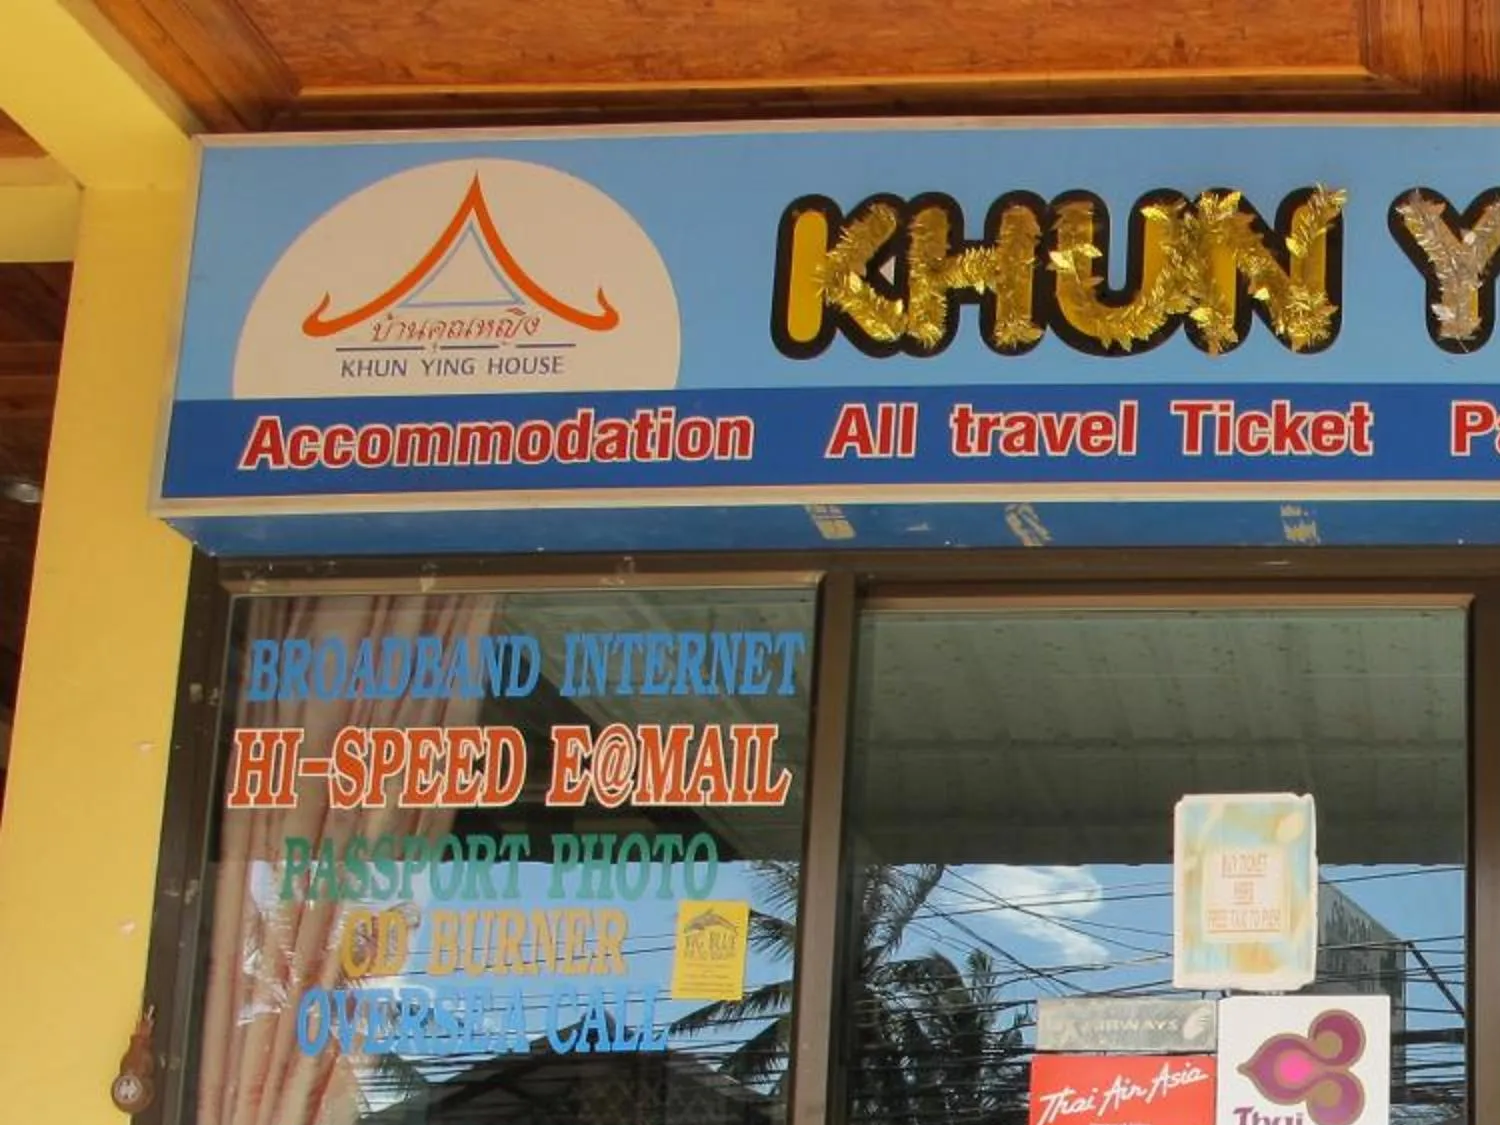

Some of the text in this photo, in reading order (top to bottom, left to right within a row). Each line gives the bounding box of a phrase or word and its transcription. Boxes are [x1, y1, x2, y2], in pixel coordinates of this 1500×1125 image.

[771, 188, 1346, 359] KHUN
[340, 355, 566, 378] KHUN YING HOUSE
[238, 406, 755, 471] Accommodation
[825, 403, 919, 460] All
[950, 401, 1139, 460] travel
[1170, 399, 1375, 458] Ticket
[246, 631, 806, 702] BROADBAND INTERNET
[227, 724, 792, 809] HI-SPEED E@MAIL
[279, 832, 719, 900] PASSPORT PHOTO
[341, 909, 629, 979] CD BURNER
[296, 986, 669, 1057] OVERSEA CALL
[1096, 1076, 1149, 1117] Air
[1145, 1061, 1209, 1104] Asia
